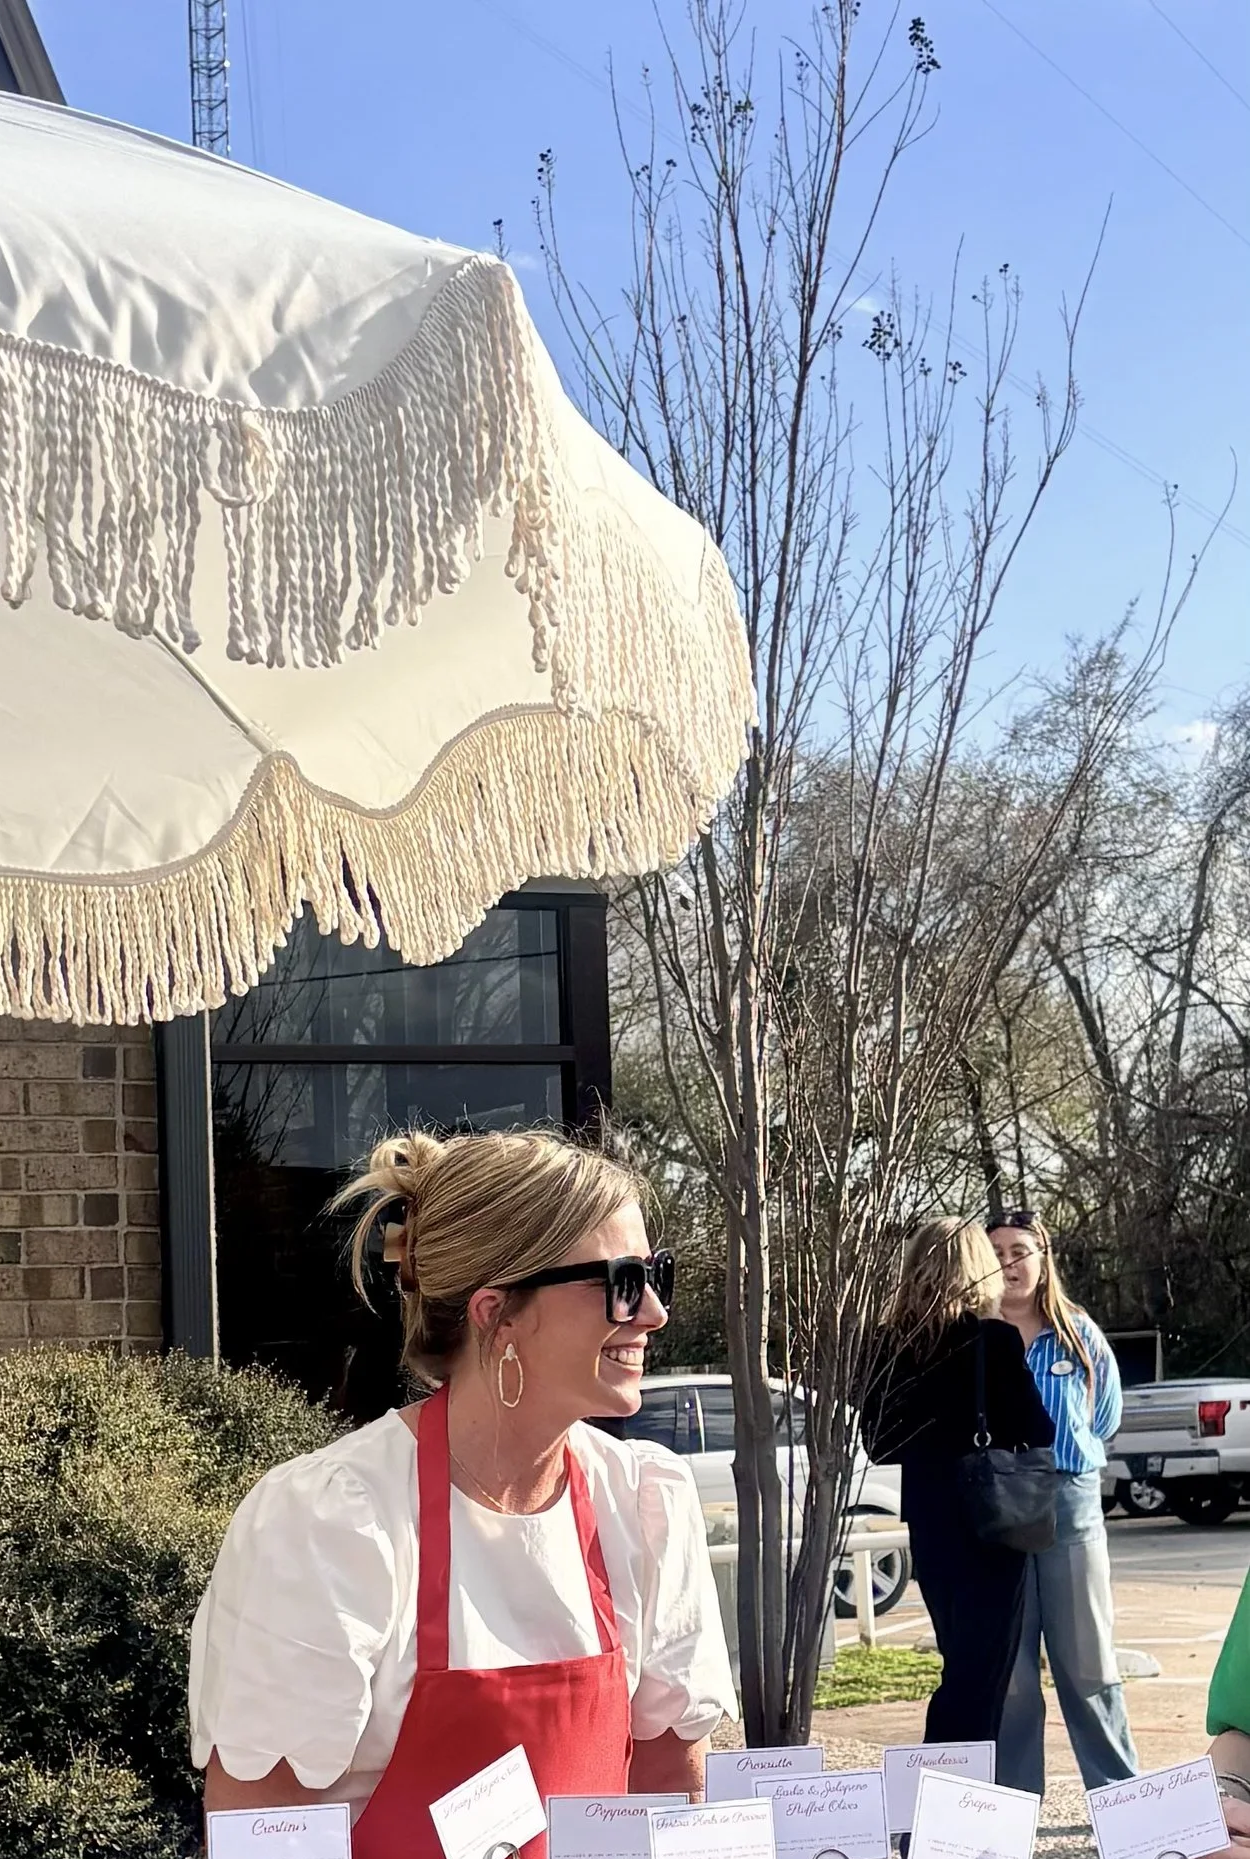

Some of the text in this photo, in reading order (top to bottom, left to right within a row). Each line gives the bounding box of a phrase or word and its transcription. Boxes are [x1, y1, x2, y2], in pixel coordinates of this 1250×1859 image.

[1140, 1782, 1165, 1800] Dry
[828, 1799, 859, 1814] Olives
[958, 1791, 998, 1813] Grapes
[584, 1802, 648, 1822] Pepperon
